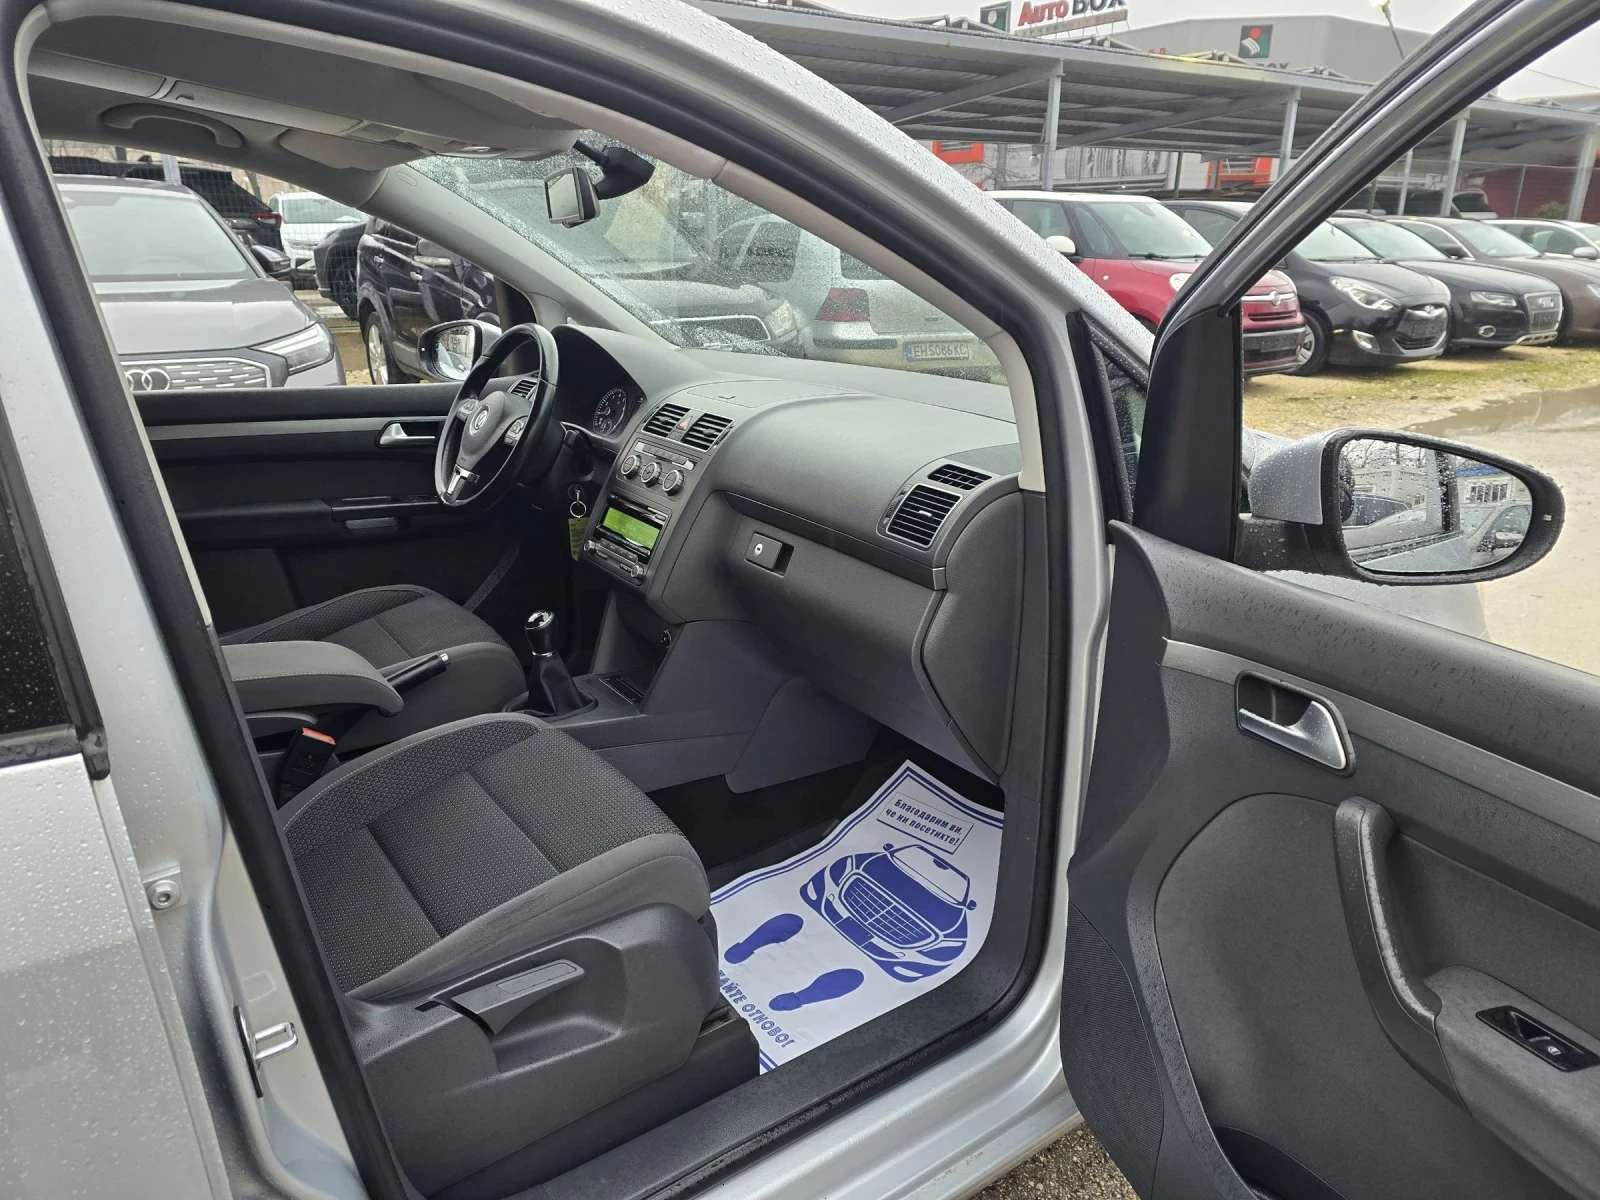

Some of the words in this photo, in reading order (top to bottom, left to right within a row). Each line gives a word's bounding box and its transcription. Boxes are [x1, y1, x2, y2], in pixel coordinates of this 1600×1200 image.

[885, 808, 897, 818] че
[896, 814, 910, 824] ни
[909, 820, 960, 846] посетихте!
[894, 799, 949, 829] Благодарим
[741, 1003, 795, 1048] ОТНОВО!
